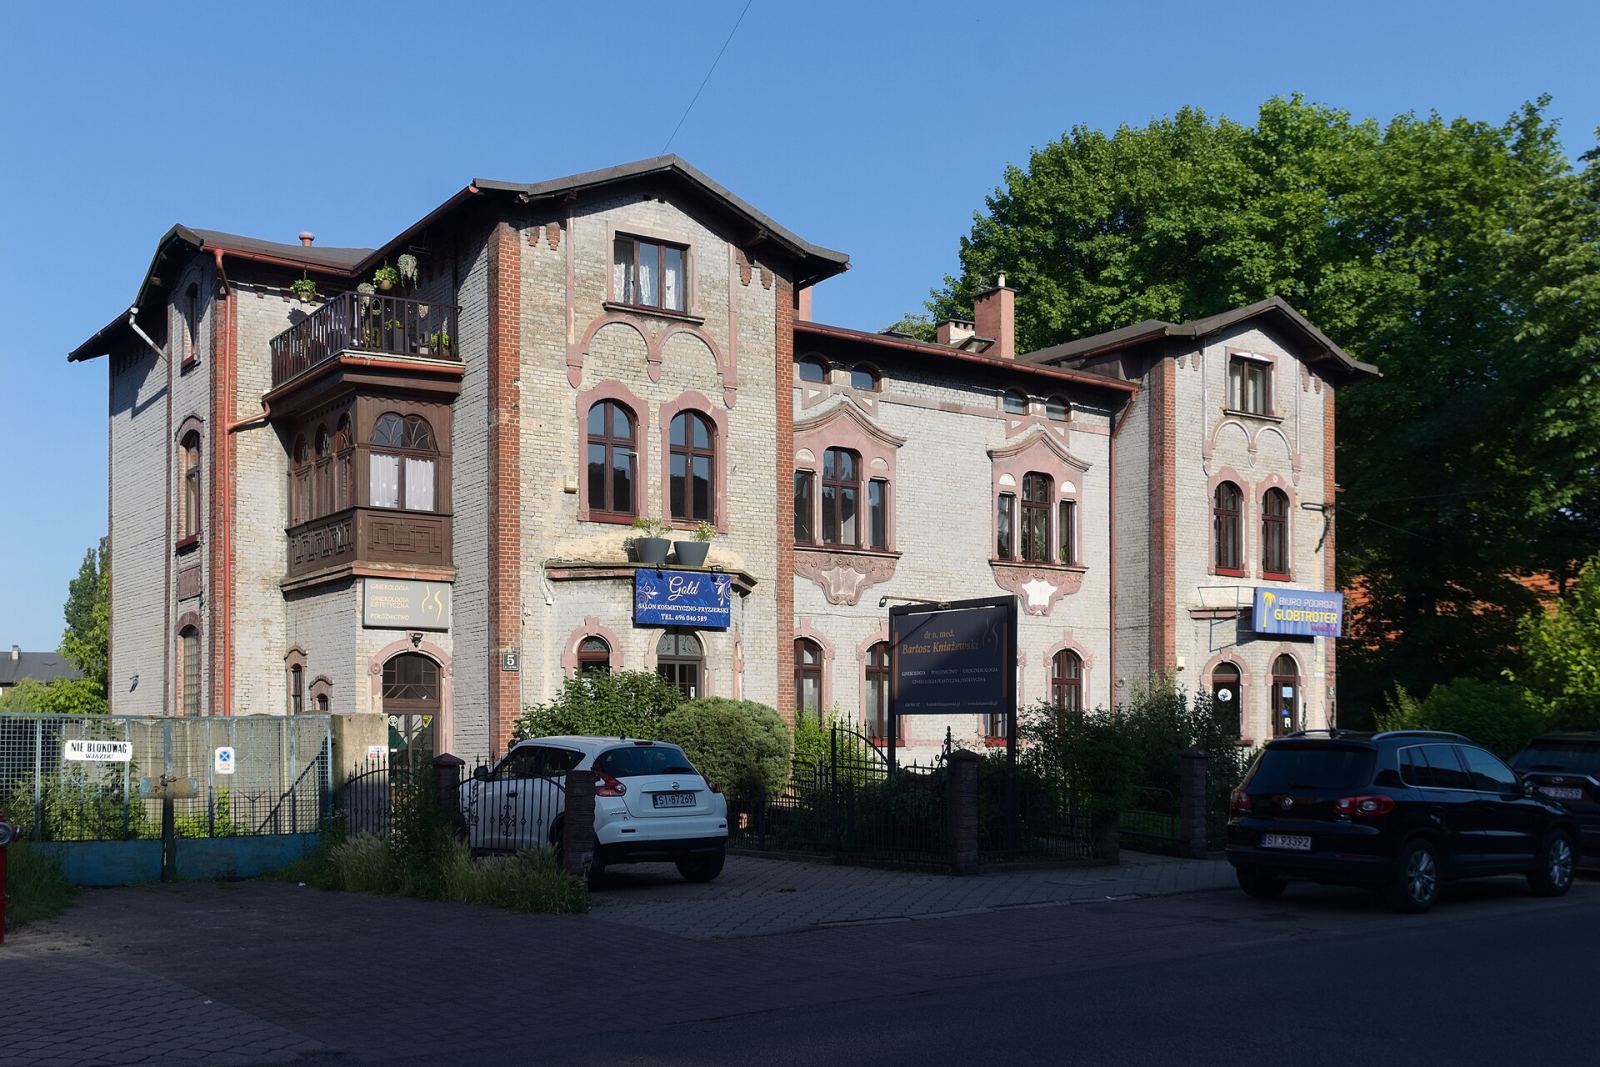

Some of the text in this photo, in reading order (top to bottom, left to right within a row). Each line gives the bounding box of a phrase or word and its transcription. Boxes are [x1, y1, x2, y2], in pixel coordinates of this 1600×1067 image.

[668, 576, 700, 601] Gold
[1279, 597, 1302, 606] BIURO
[1274, 609, 1337, 624] GLOBTROTER
[924, 631, 932, 639] dr
[938, 629, 955, 638] med.
[902, 643, 931, 655] Bartosz
[507, 655, 515, 666] 5
[71, 742, 84, 752] NIE
[670, 794, 693, 804] 87269
